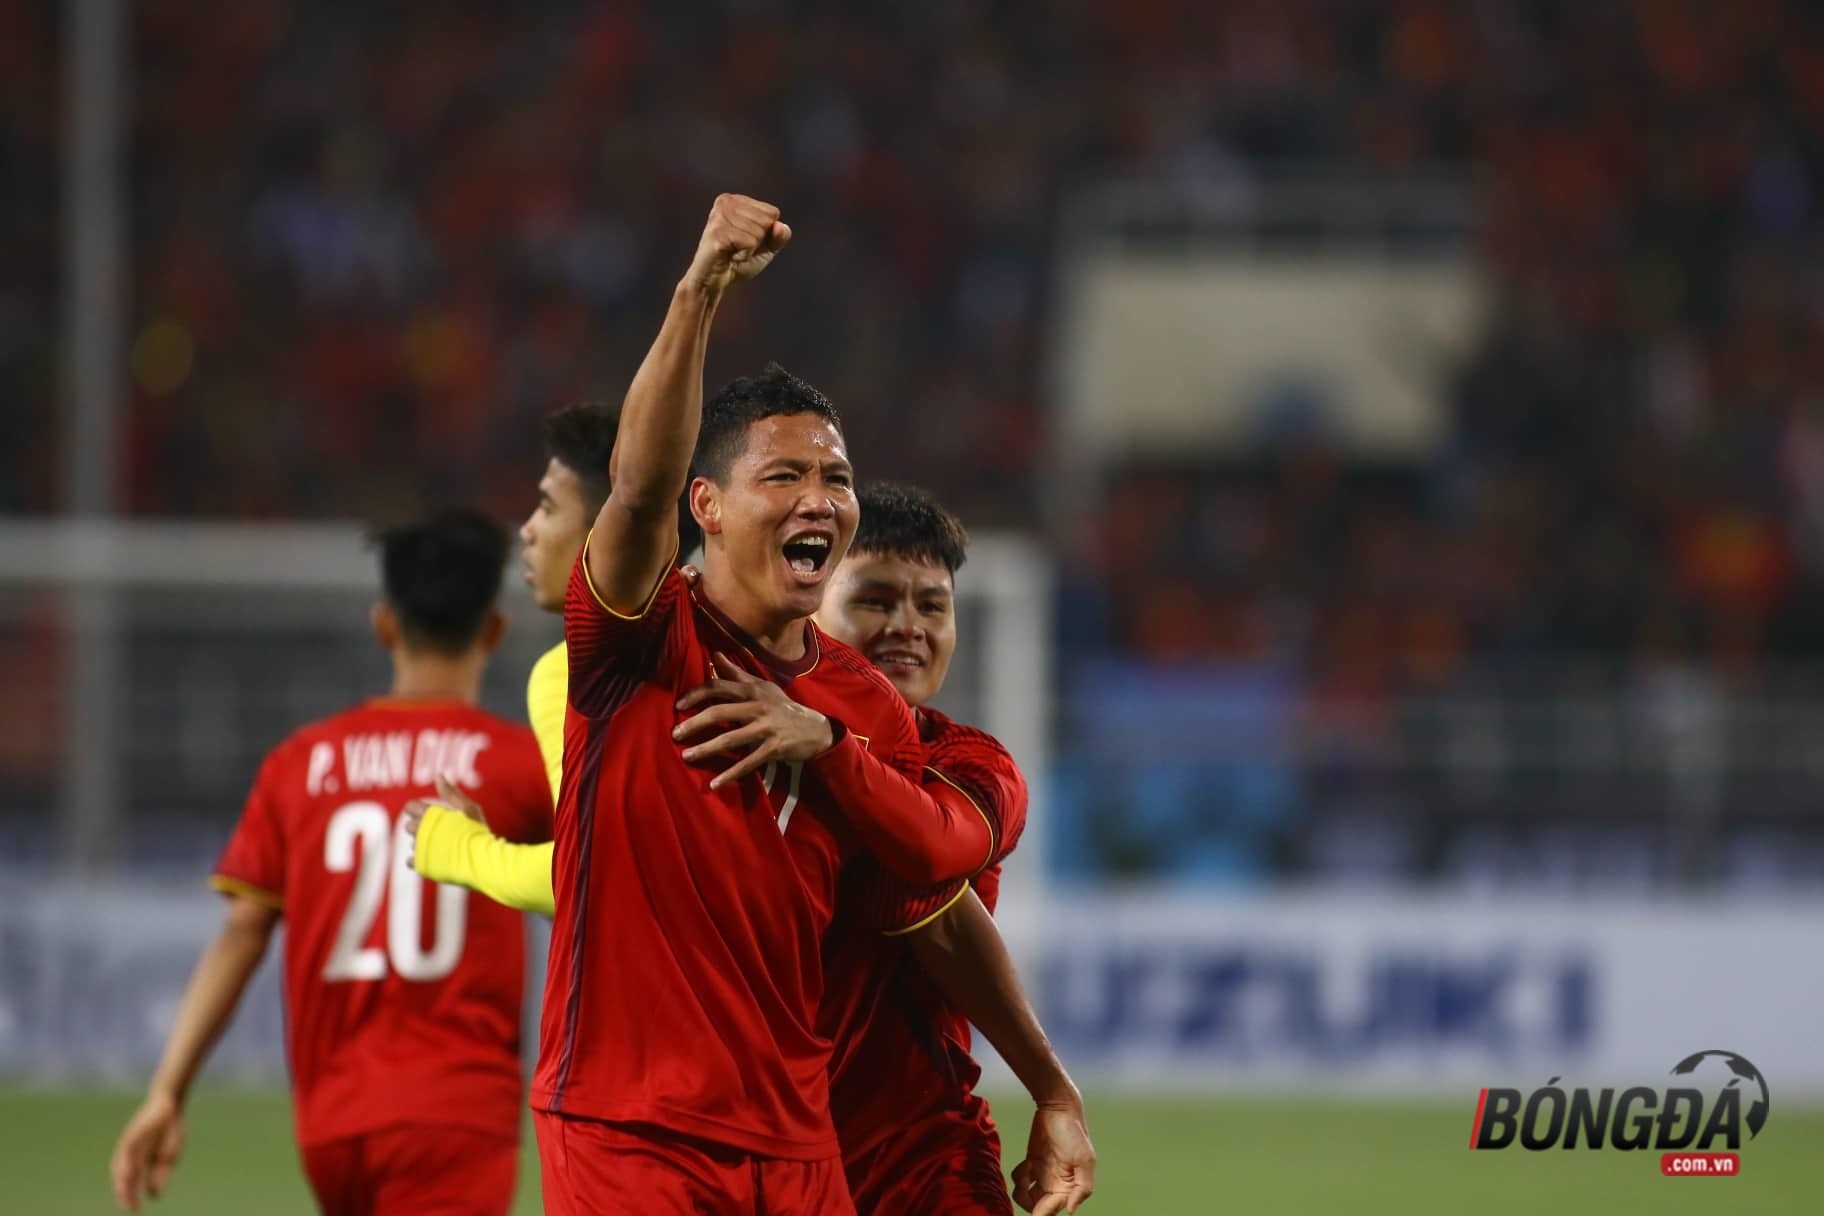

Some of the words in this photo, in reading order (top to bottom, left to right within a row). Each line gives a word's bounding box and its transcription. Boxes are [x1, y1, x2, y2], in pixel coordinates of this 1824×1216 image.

[306, 742, 339, 796] P.
[321, 801, 469, 982] 20
[1036, 942, 1592, 1058] UZUKI
